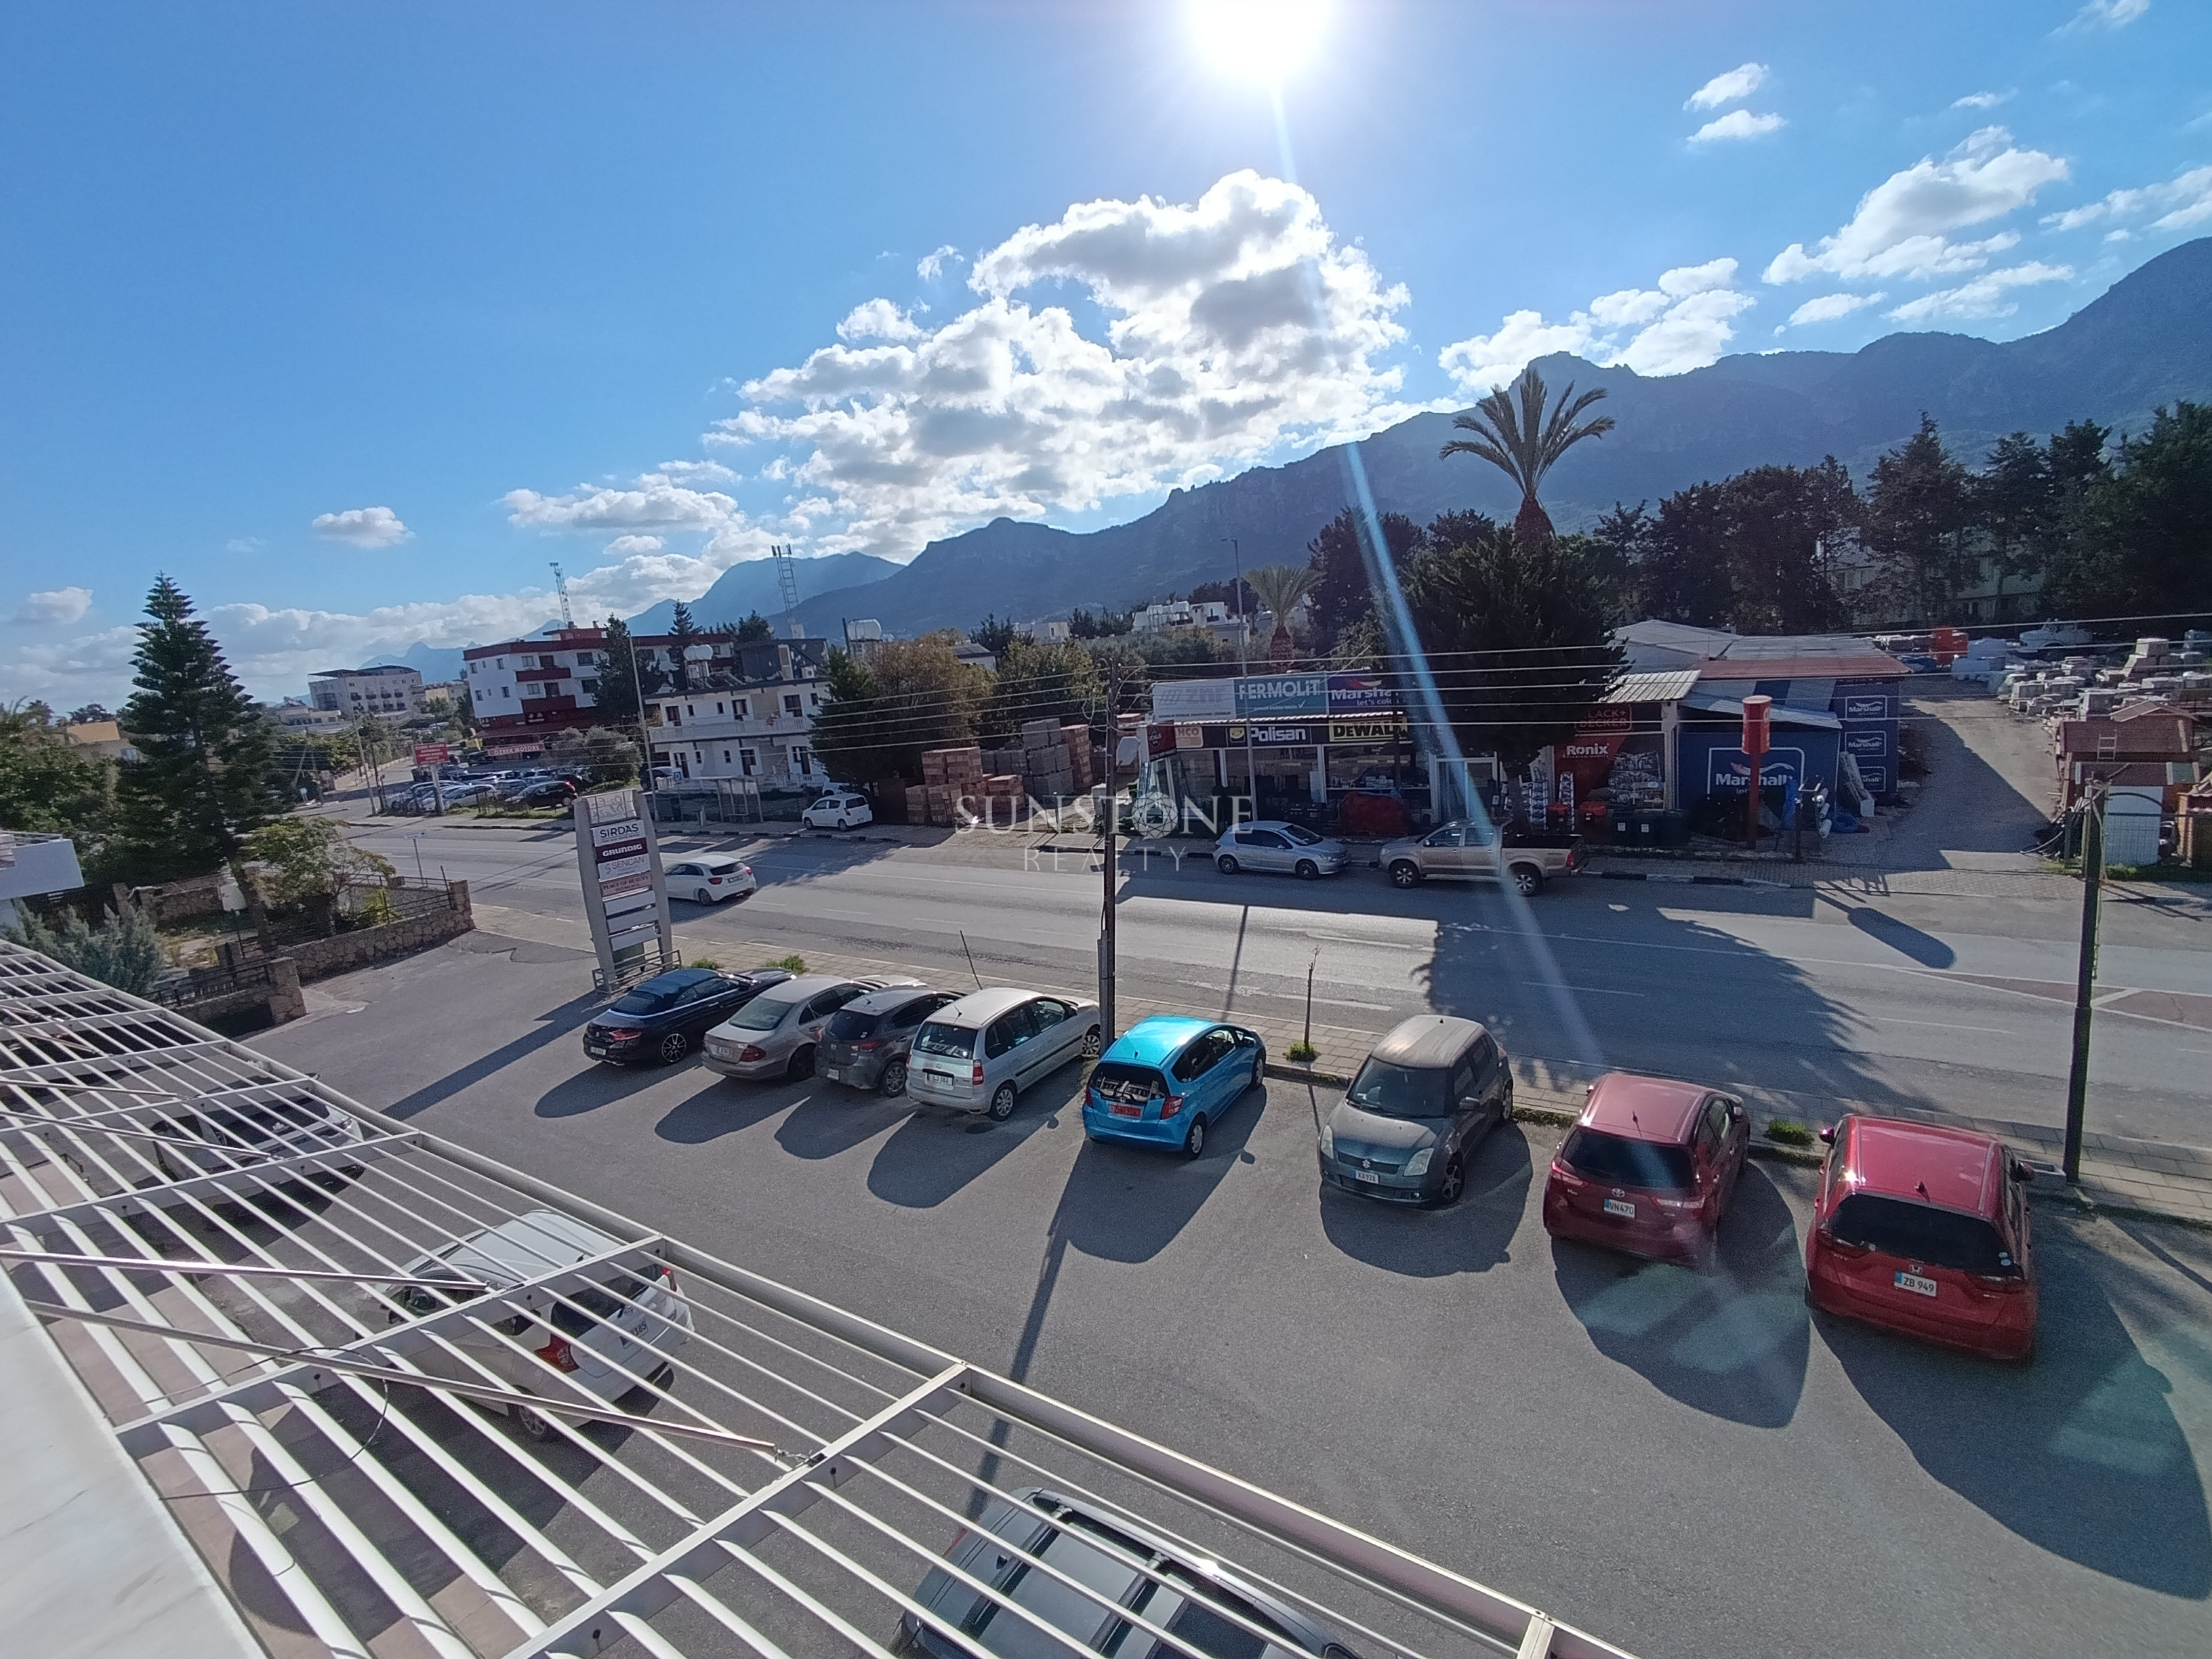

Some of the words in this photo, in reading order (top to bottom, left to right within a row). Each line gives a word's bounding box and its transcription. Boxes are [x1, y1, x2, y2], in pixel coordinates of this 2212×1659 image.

[1331, 687, 1392, 700] Marsha
[1588, 709, 1626, 718] LACK+
[1250, 726, 1306, 742] Polisan
[1333, 722, 1395, 737] DEWAL
[1566, 743, 1609, 755] Ronix
[600, 823, 639, 838] SIRDAS
[602, 843, 642, 857] GRUNDIG
[1904, 1277, 1915, 1288] ZB
[1917, 1281, 1934, 1292] 949
